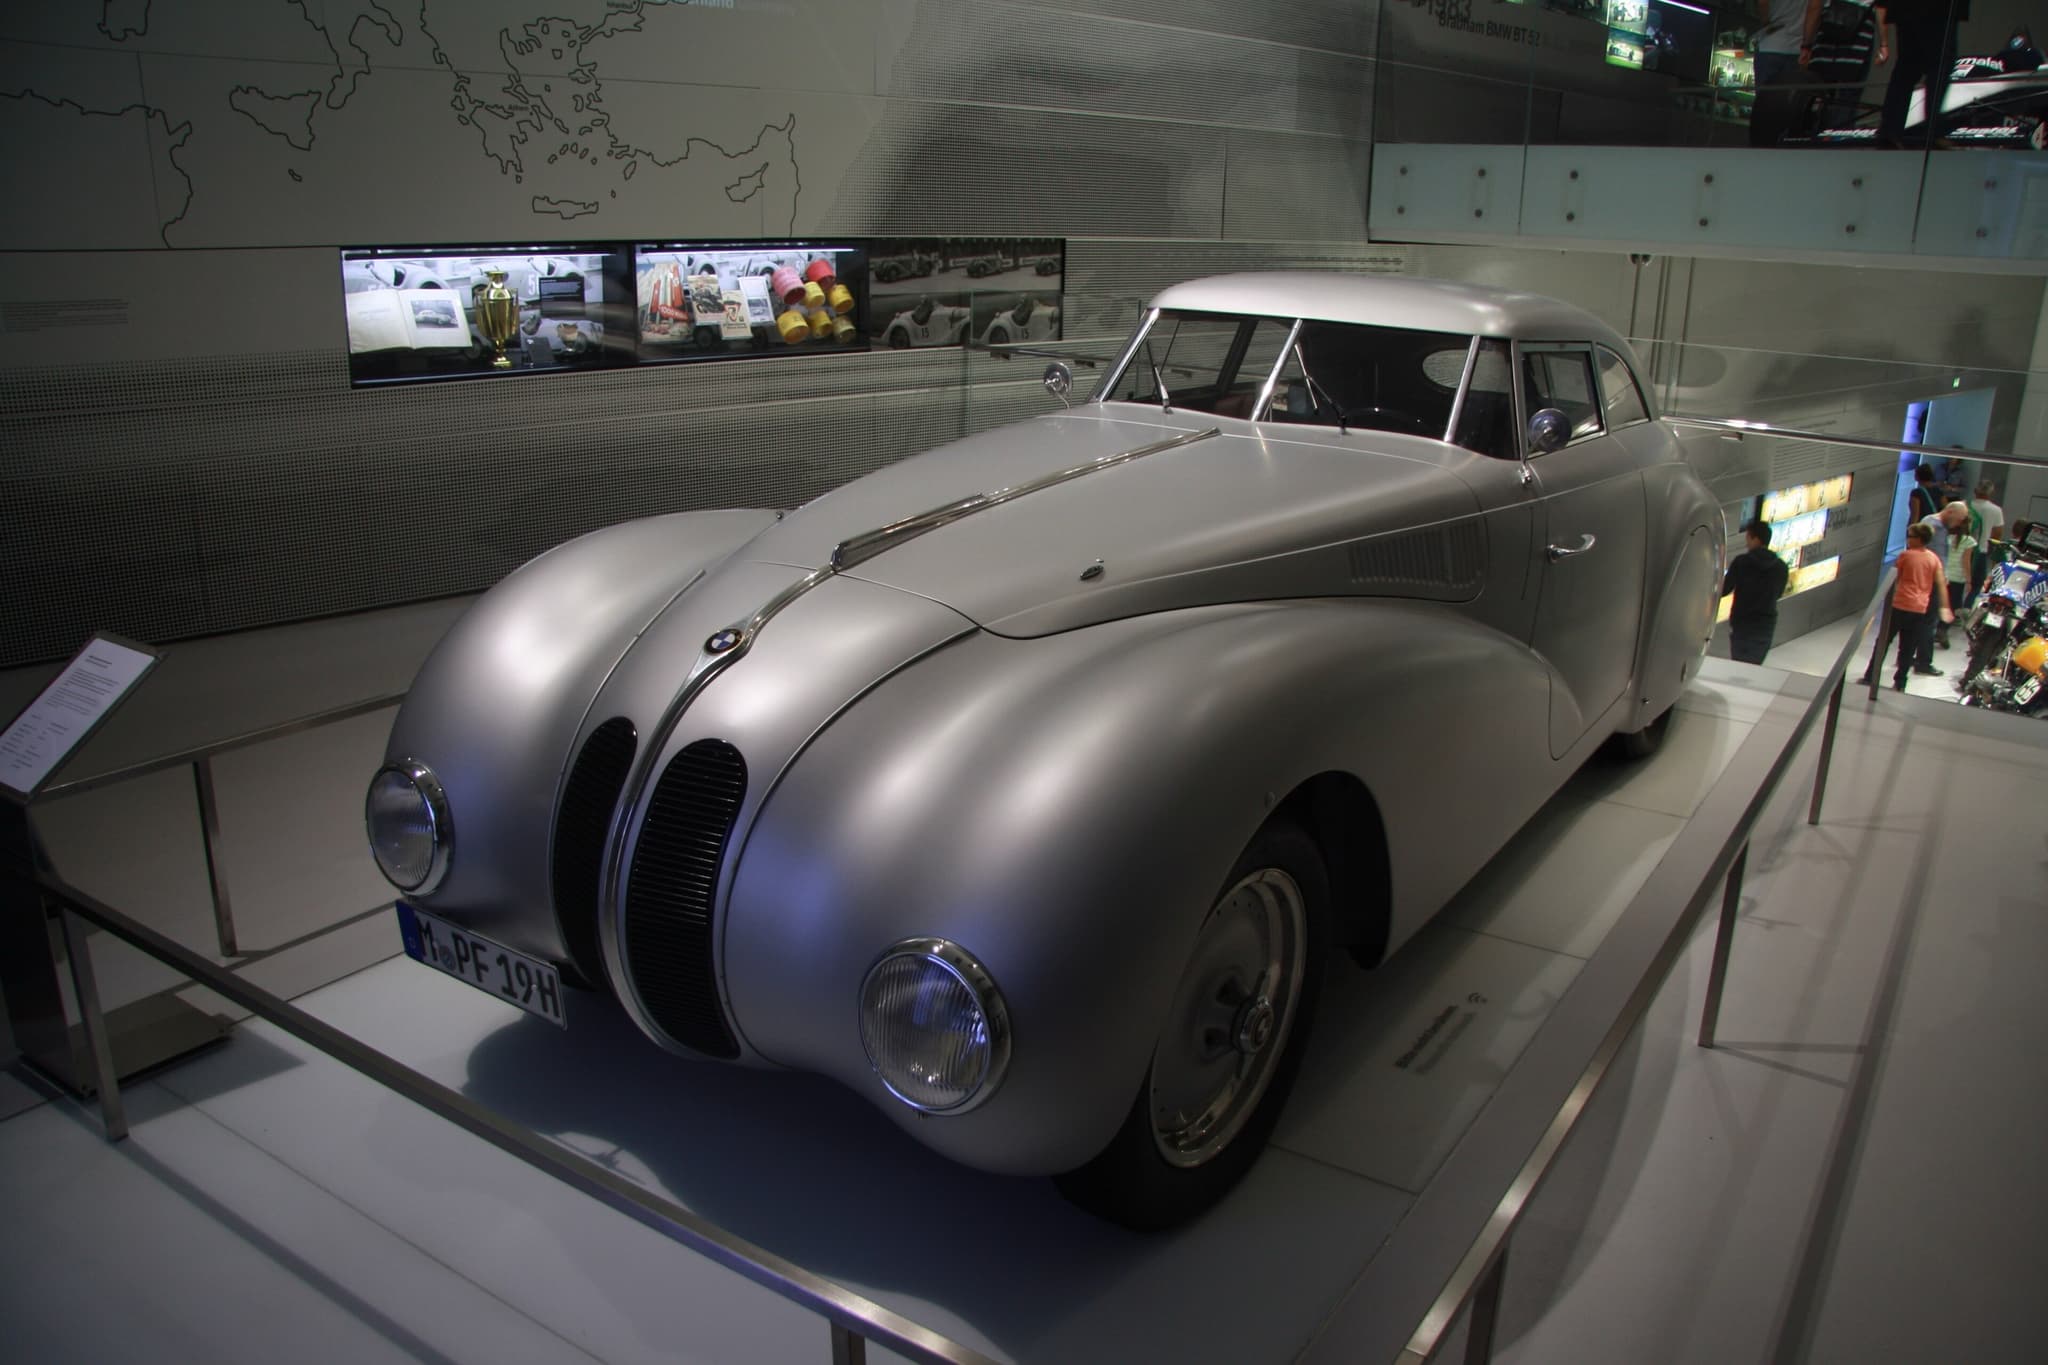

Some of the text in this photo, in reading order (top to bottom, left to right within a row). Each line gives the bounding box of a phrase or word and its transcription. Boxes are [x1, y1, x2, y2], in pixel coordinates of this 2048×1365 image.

[1486, 21, 1512, 41] BMW
[1513, 27, 1528, 44] BT
[921, 327, 929, 338] 15
[416, 916, 562, 1019] M PF 19H
